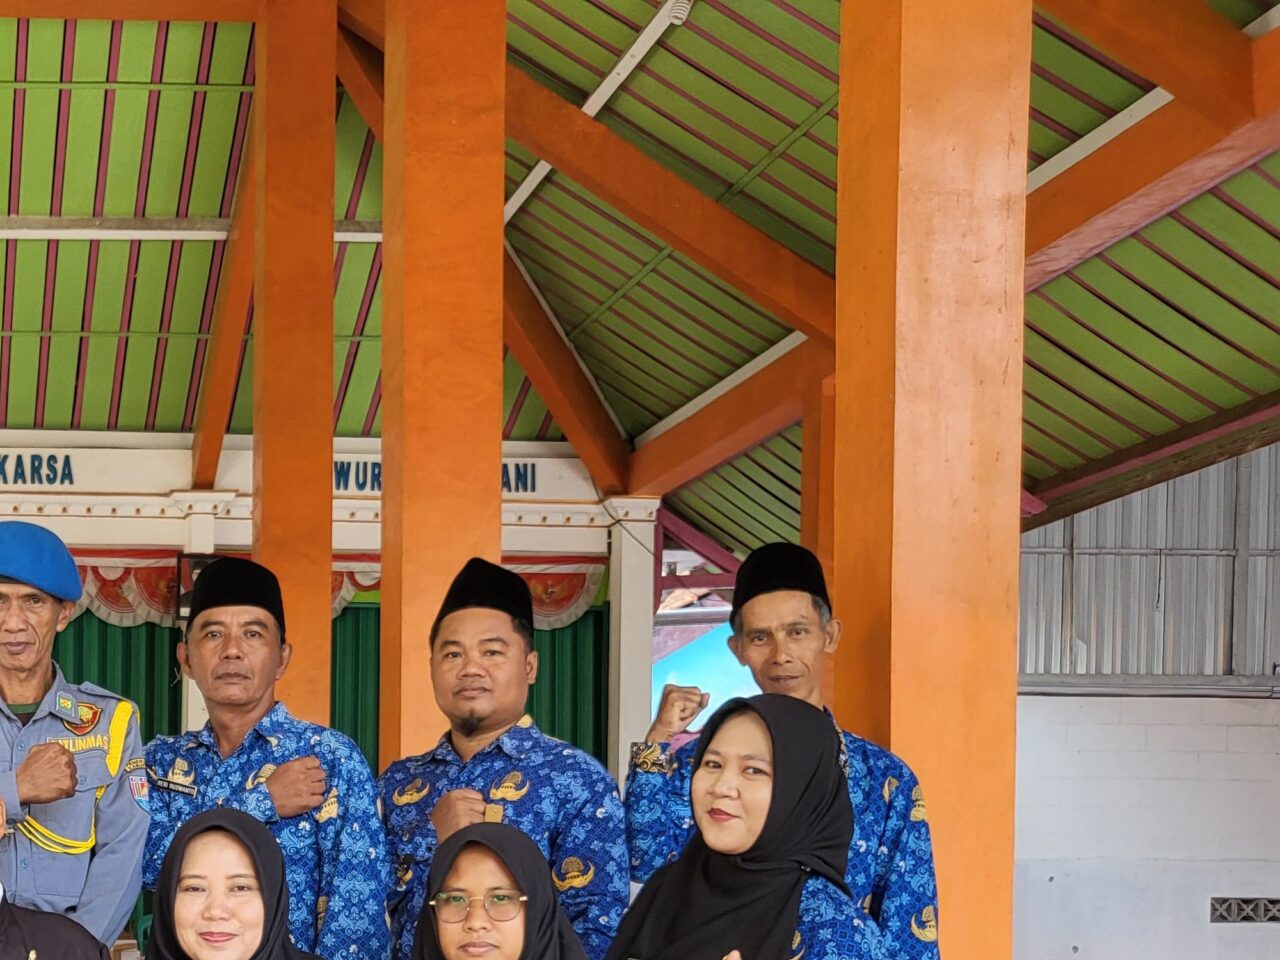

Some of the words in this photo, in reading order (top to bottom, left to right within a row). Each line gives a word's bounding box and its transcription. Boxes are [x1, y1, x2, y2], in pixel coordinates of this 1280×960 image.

[334, 461, 382, 491] WUR
[501, 463, 536, 493] ANI
[50, 735, 109, 753] TLINMAS
